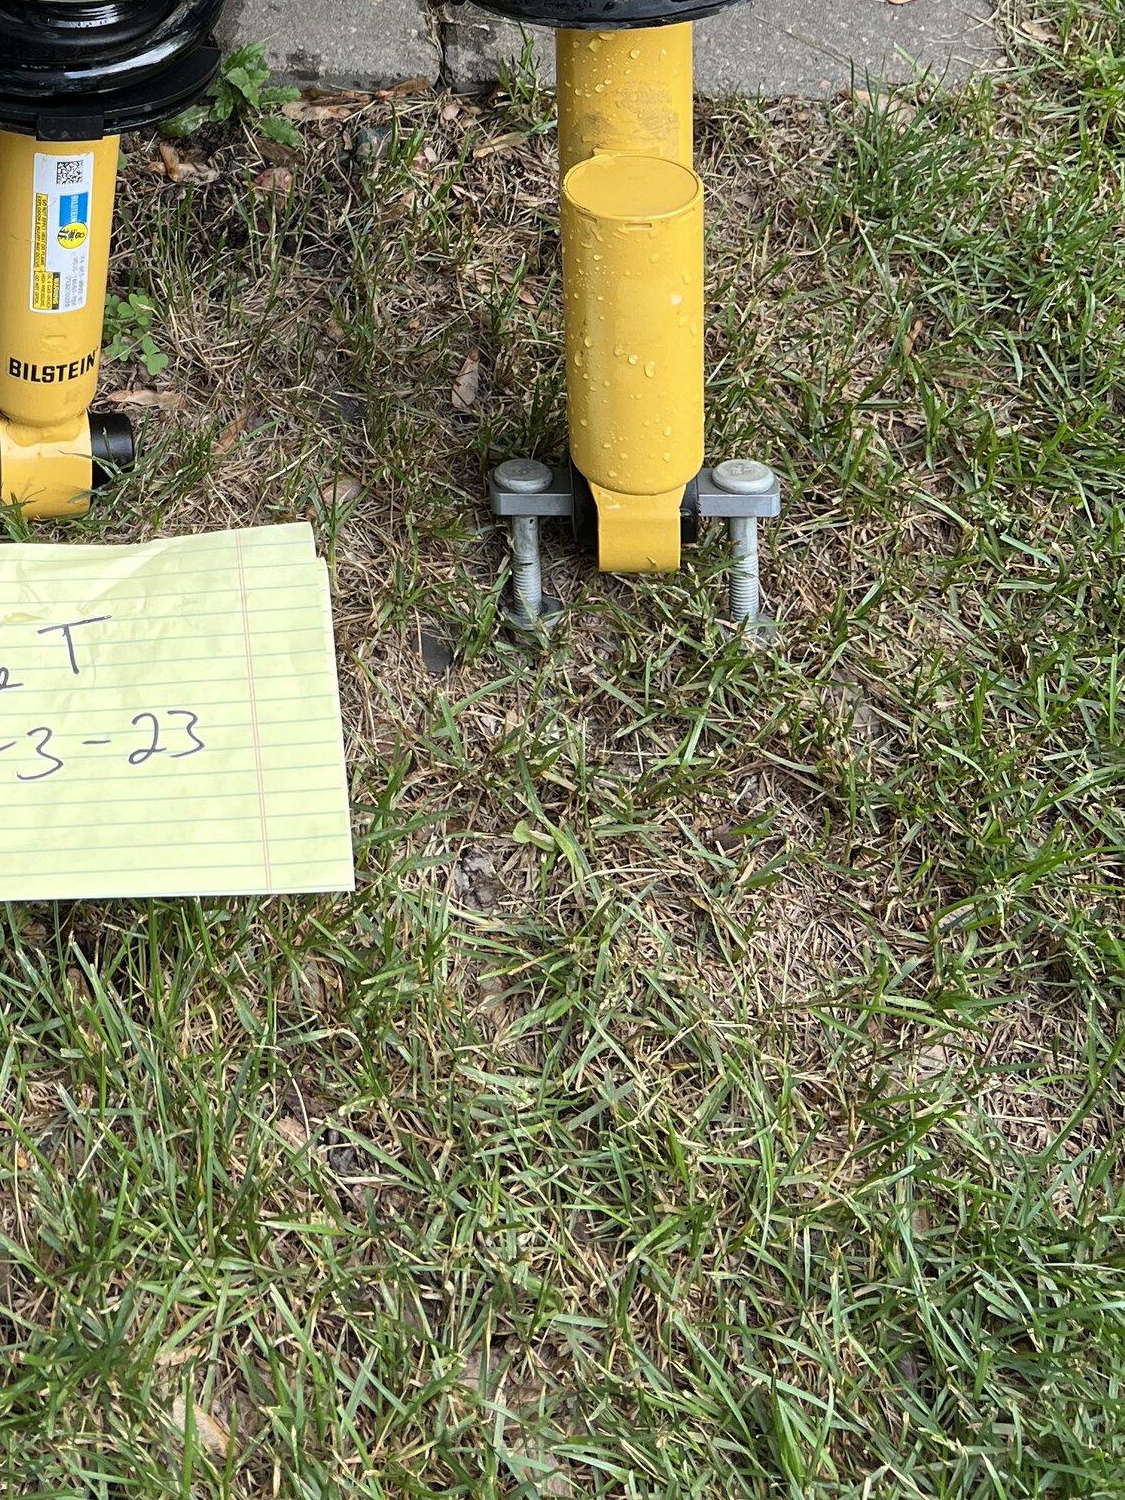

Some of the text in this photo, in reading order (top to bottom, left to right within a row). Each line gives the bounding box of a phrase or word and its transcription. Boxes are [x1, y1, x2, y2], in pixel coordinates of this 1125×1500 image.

[70, 194, 79, 222] BILSTEIN
[8, 349, 97, 384] BILSTEIN
[36, 614, 113, 675] T
